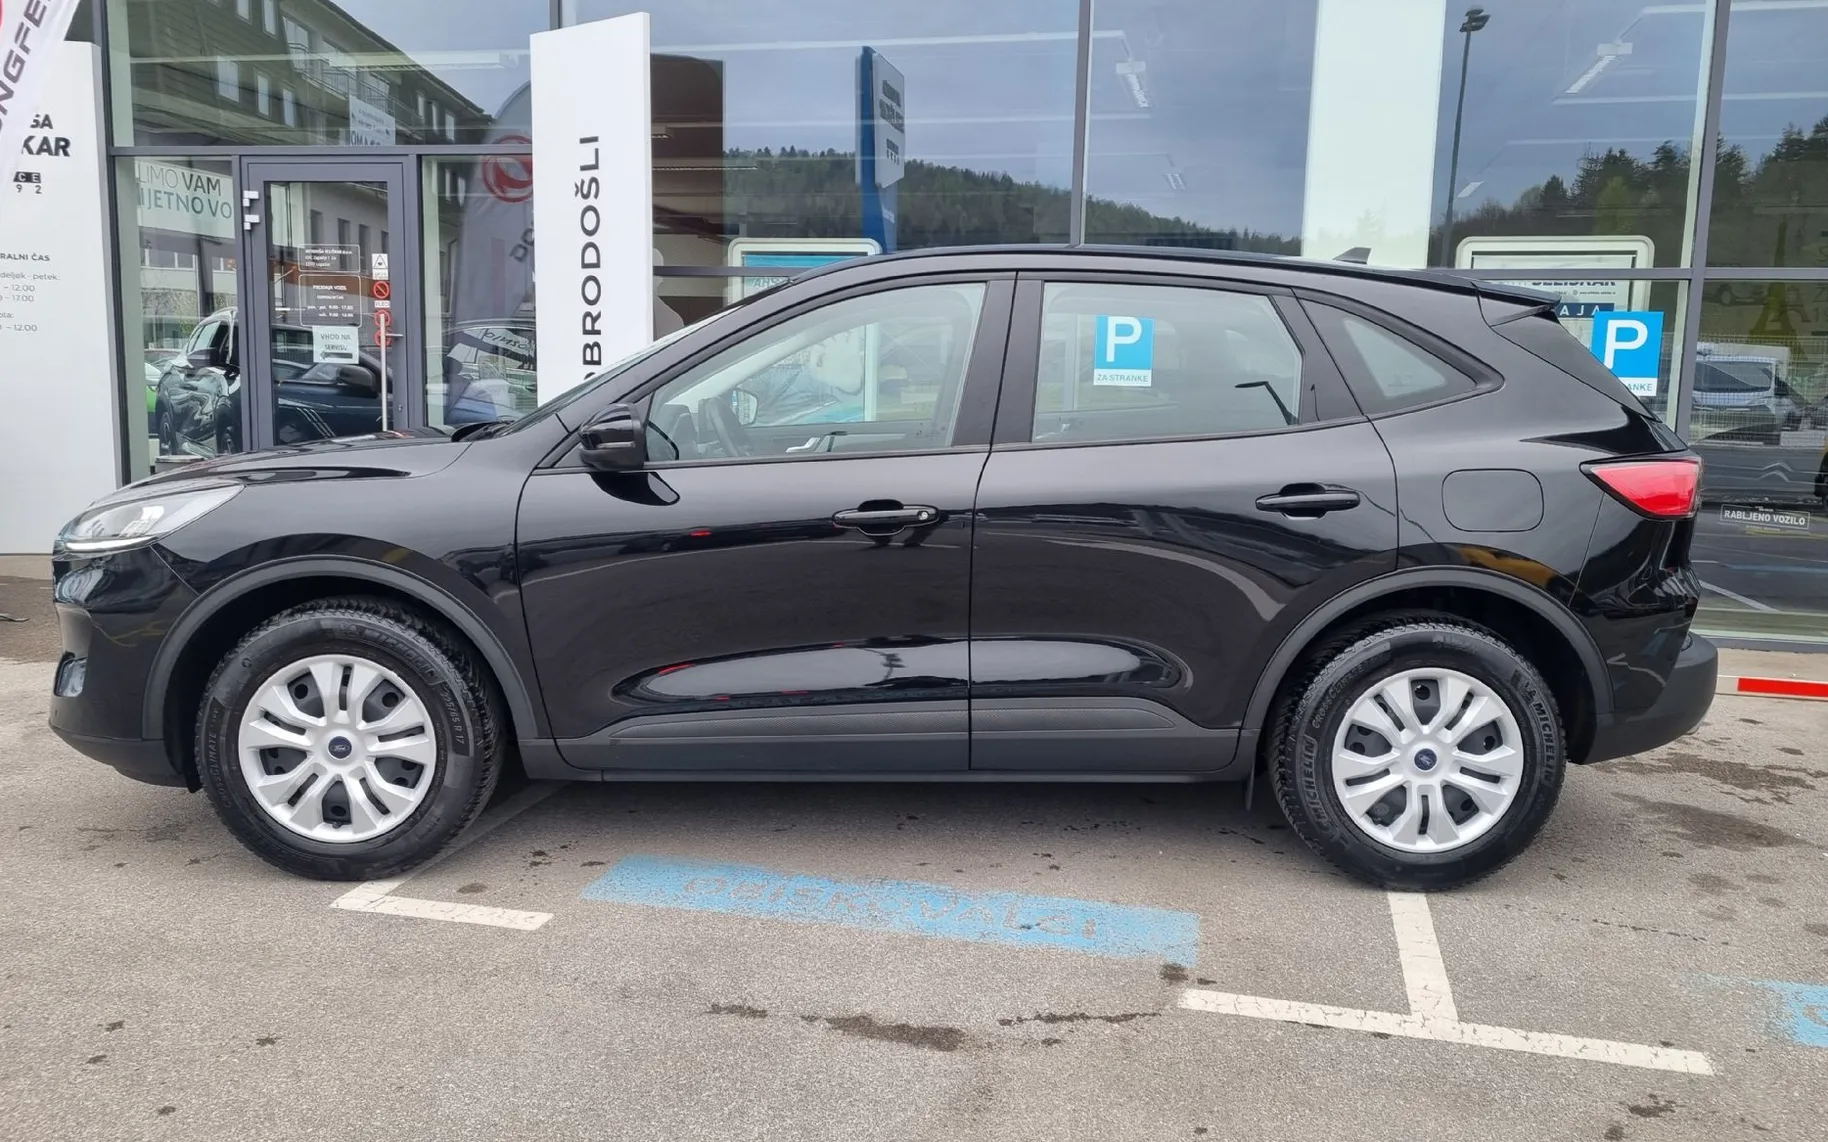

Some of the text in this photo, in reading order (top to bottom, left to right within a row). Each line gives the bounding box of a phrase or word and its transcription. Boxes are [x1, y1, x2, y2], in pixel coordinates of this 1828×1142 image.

[182, 171, 221, 197] VAM
[207, 198, 232, 219] VO
[31, 252, 51, 262] ČAS
[12, 284, 36, 292] 12.00
[14, 324, 38, 332] 12.00
[1106, 316, 1142, 362] P
[1604, 320, 1648, 369] P
[1109, 374, 1148, 382] STRANKE
[1724, 509, 1806, 526] RABLJENO VOZILO
[1533, 702, 1556, 782] MICHELIN
[1303, 740, 1328, 820] MICHELIN
